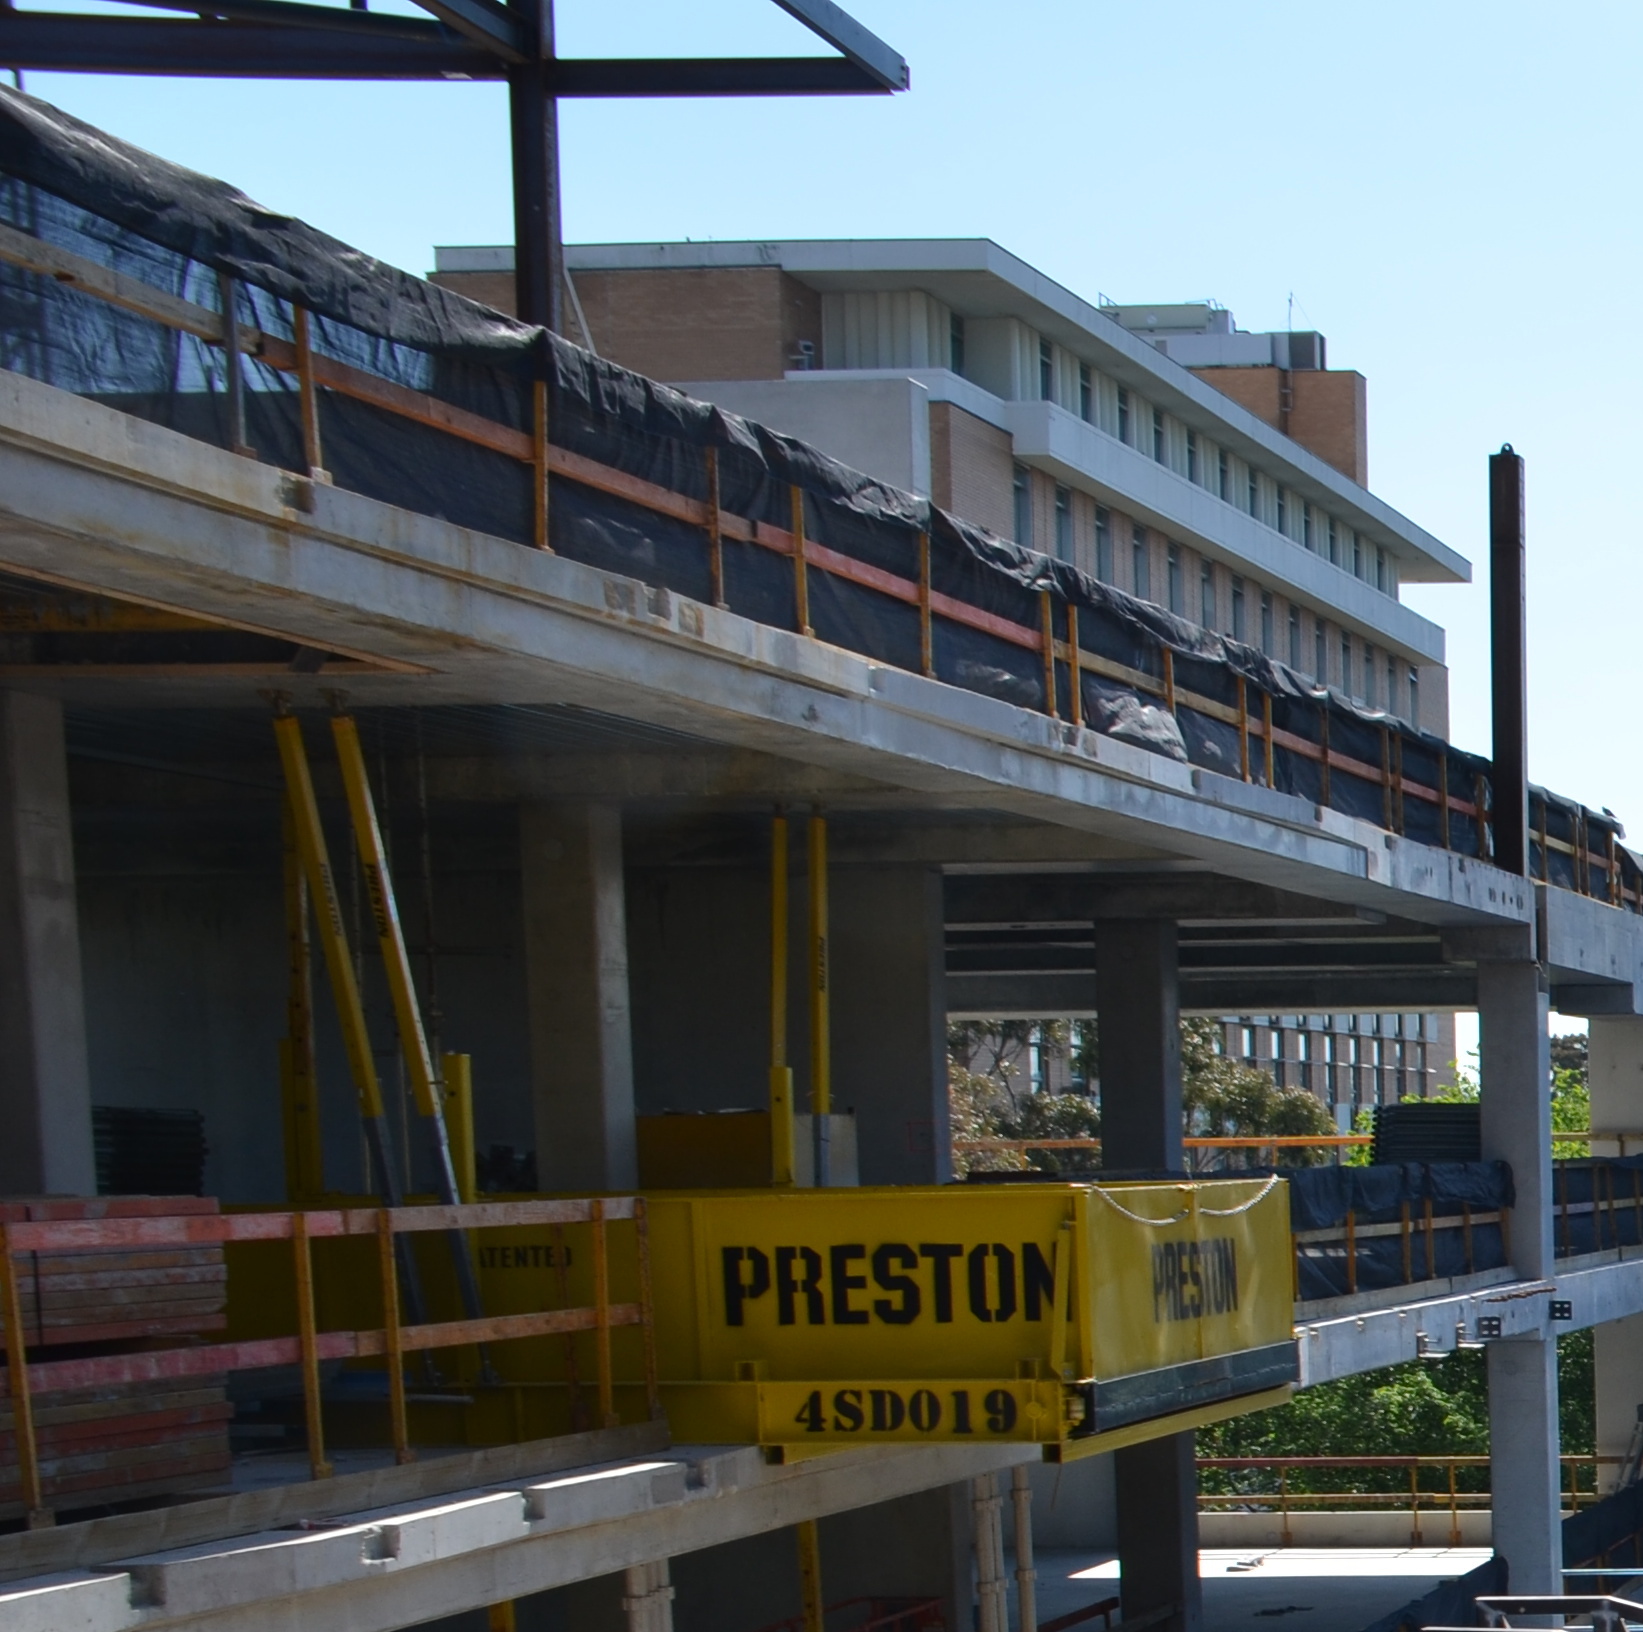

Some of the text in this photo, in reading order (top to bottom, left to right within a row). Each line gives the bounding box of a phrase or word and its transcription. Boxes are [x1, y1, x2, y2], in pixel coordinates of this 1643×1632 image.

[365, 863, 390, 938] PRESTON
[721, 1242, 1073, 1327] PRESTON
[1151, 1237, 1239, 1323] PRESTON
[795, 1388, 1018, 1434] 4SD019
